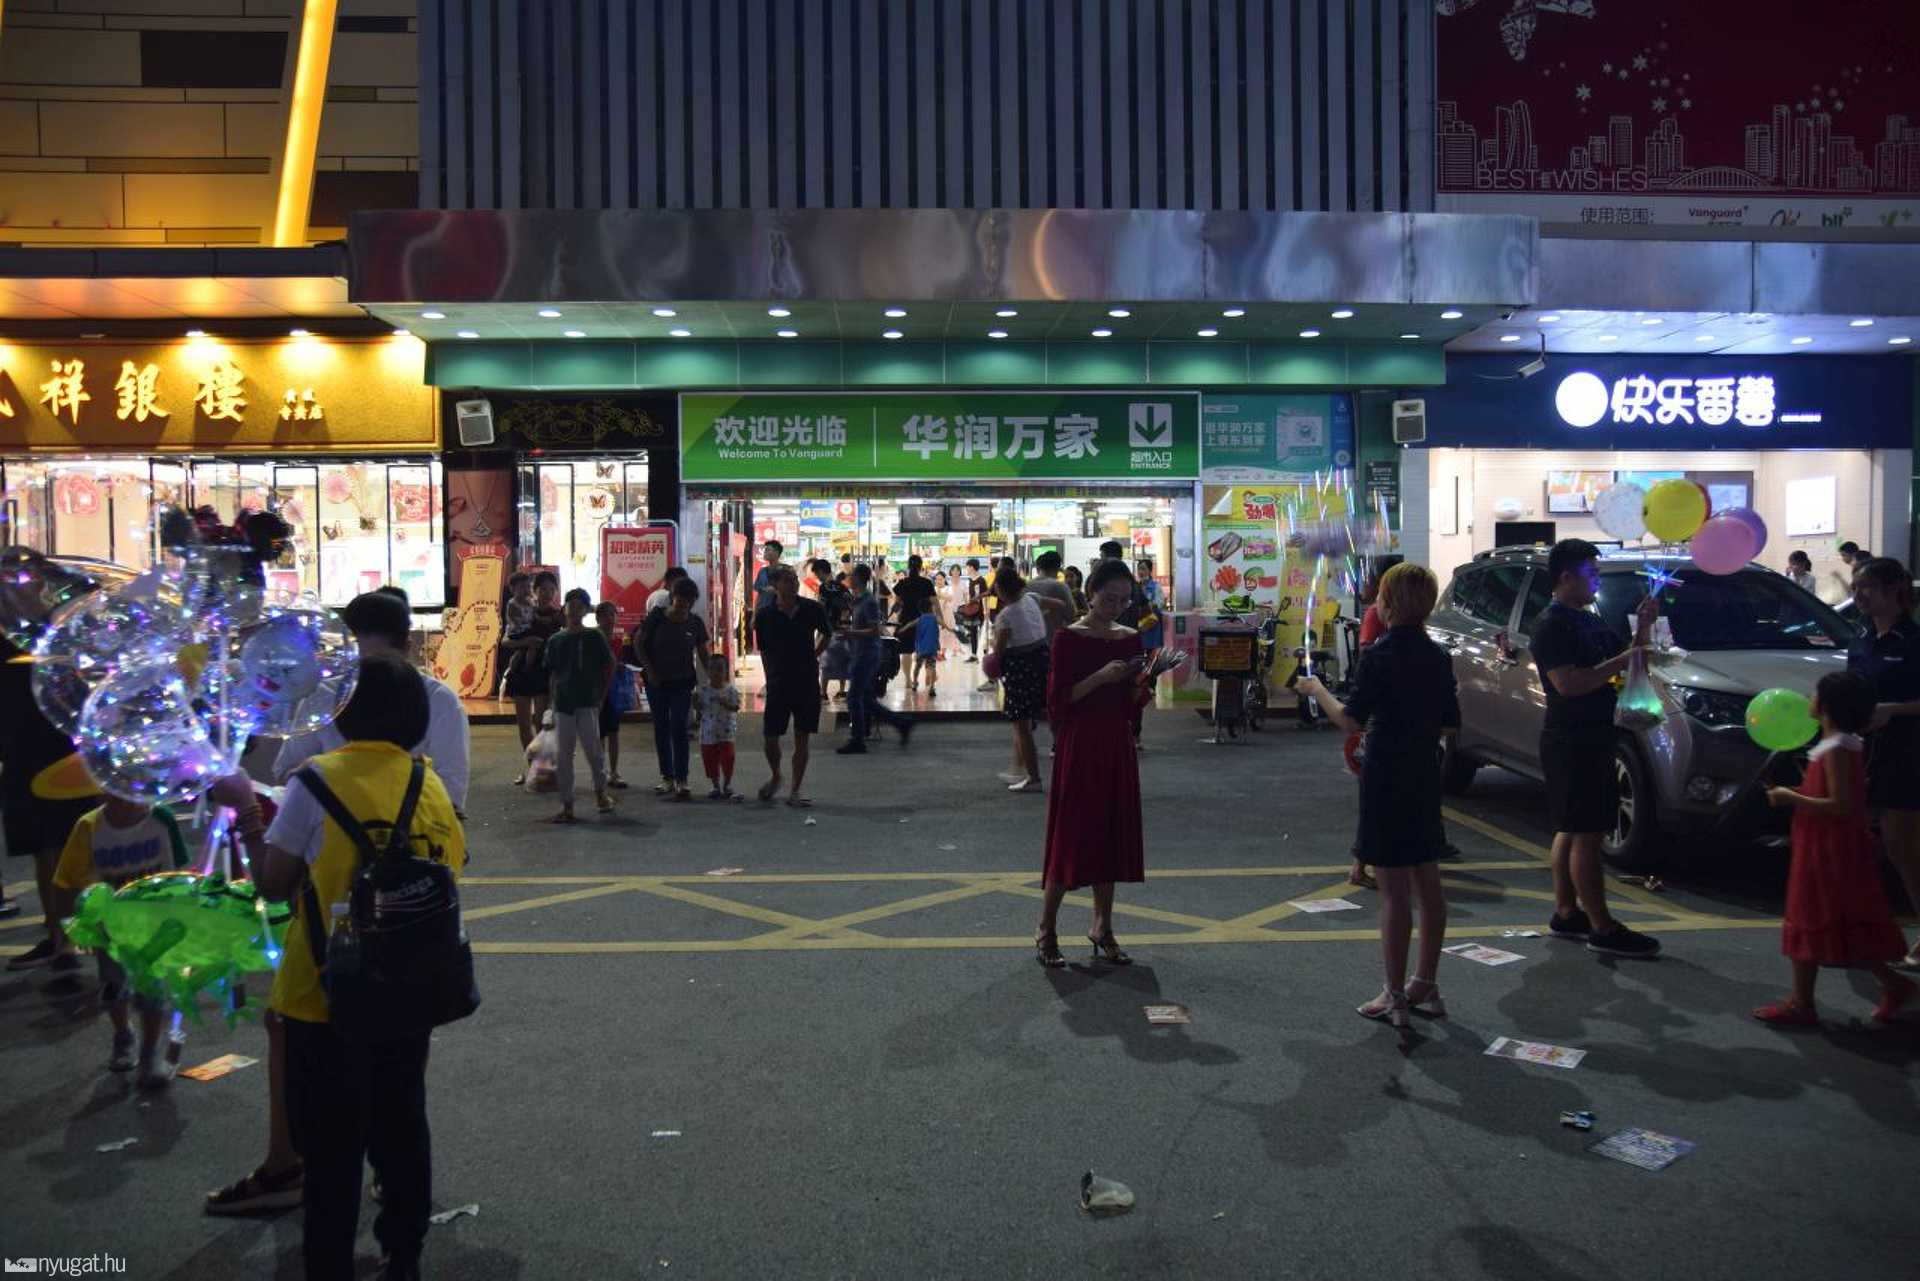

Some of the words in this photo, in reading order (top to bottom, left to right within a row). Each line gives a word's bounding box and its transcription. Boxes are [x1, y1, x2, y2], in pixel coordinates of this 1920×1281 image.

[1477, 168, 1538, 190] BEST
[1552, 169, 1647, 191] WISHES
[1611, 375, 1775, 426] 快乐番薯
[714, 415, 847, 447] 欢迎光临
[902, 413, 1100, 460] 华润万家
[718, 447, 770, 458] Welcome
[771, 447, 787, 458] To
[789, 447, 843, 460] Vanguard
